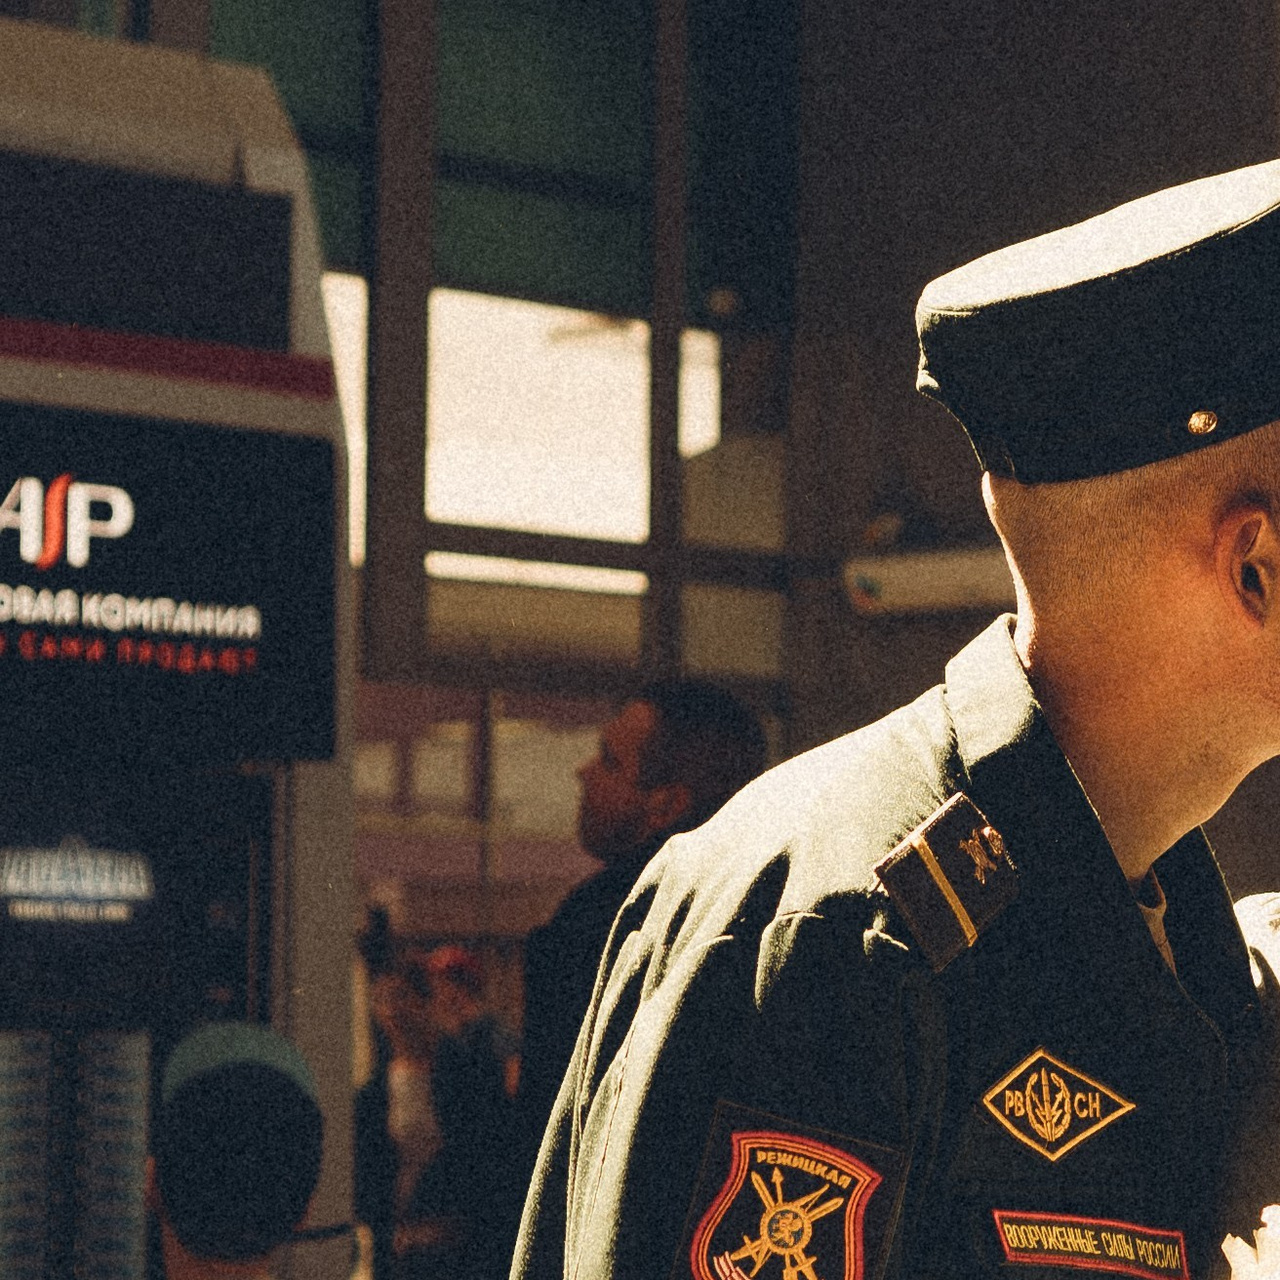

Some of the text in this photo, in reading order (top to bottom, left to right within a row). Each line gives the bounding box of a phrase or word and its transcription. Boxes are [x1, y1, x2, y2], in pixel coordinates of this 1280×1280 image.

[82, 592, 262, 640] КОМПАНИЯ
[1004, 1088, 1101, 1119] РВ СН
[756, 1149, 852, 1190] РЕЖИЦКАЯ
[1003, 1222, 1182, 1270] ВООРУЖЕННЫЕ СИЛЫ РОССИИ
